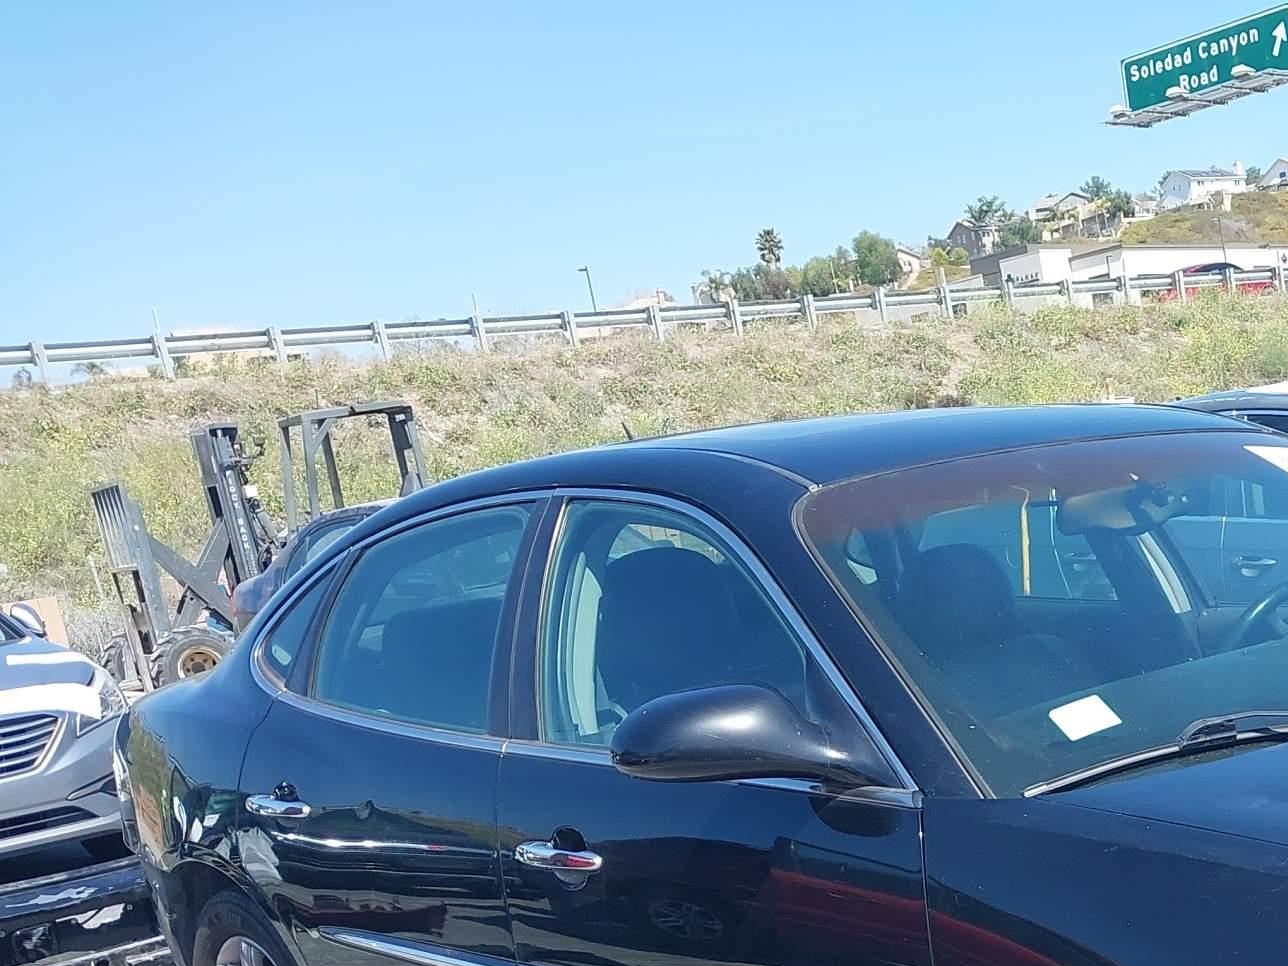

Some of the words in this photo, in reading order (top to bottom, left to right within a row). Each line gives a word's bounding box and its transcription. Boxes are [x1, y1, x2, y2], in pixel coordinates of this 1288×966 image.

[1130, 46, 1192, 82] Soledad
[1199, 28, 1259, 59] Canyon
[1178, 65, 1218, 90] Road
